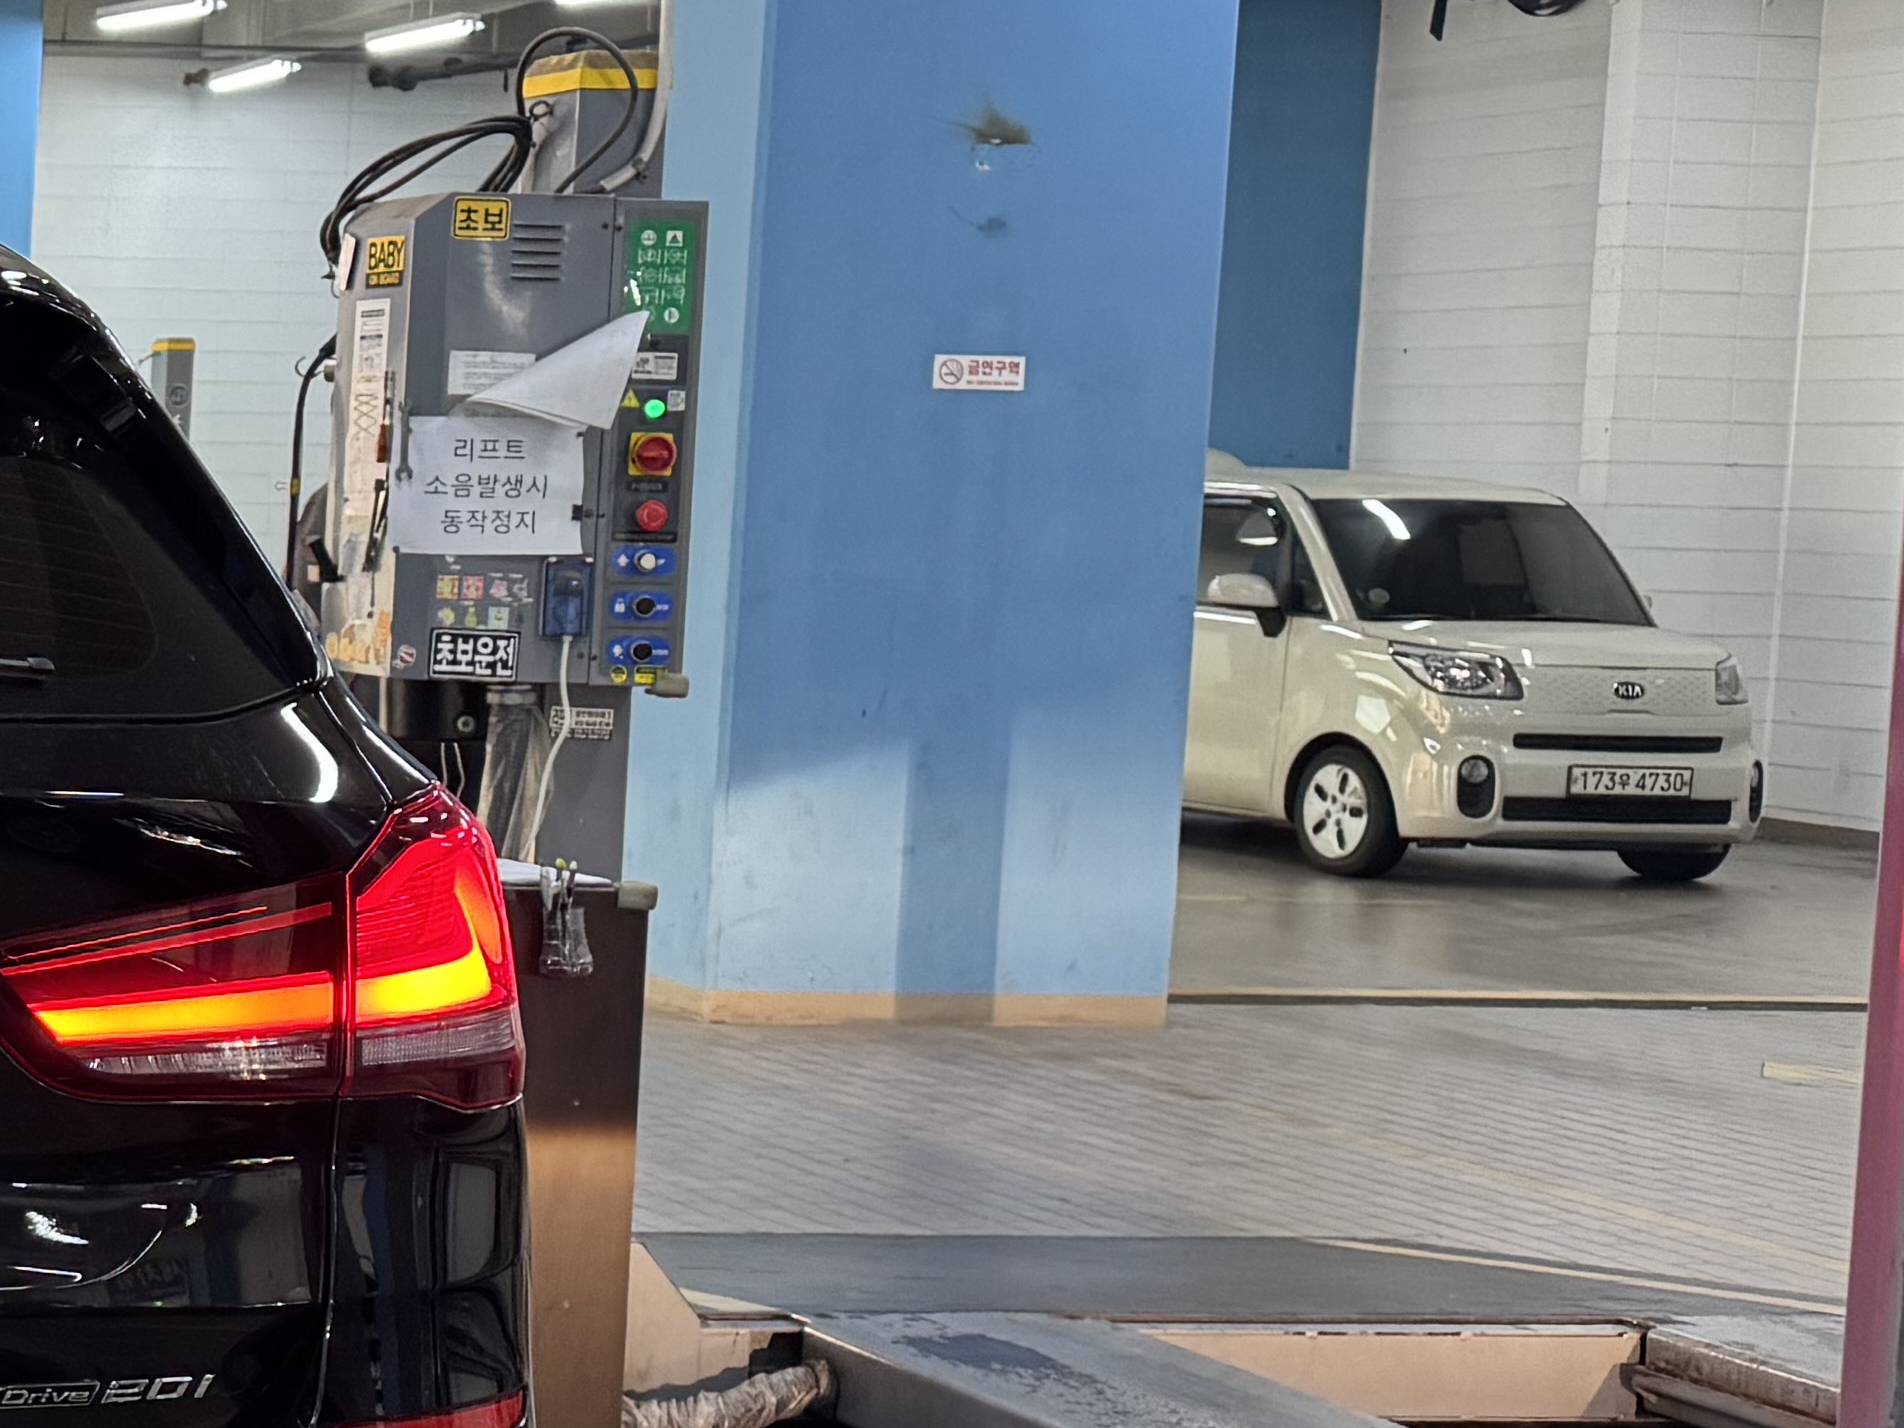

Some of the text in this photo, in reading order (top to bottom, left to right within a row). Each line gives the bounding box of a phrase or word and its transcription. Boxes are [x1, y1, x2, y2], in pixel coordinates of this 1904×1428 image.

[457, 206, 504, 232] 초보
[368, 240, 405, 271] BABY
[968, 359, 1021, 377] 금연구역
[454, 438, 526, 462] 리프트
[424, 473, 548, 499] 소음발생시
[441, 510, 537, 534] 동작정지
[433, 635, 515, 677] 초보운전
[1618, 684, 1642, 697] KIA
[1581, 770, 1685, 792] 173우 4730
